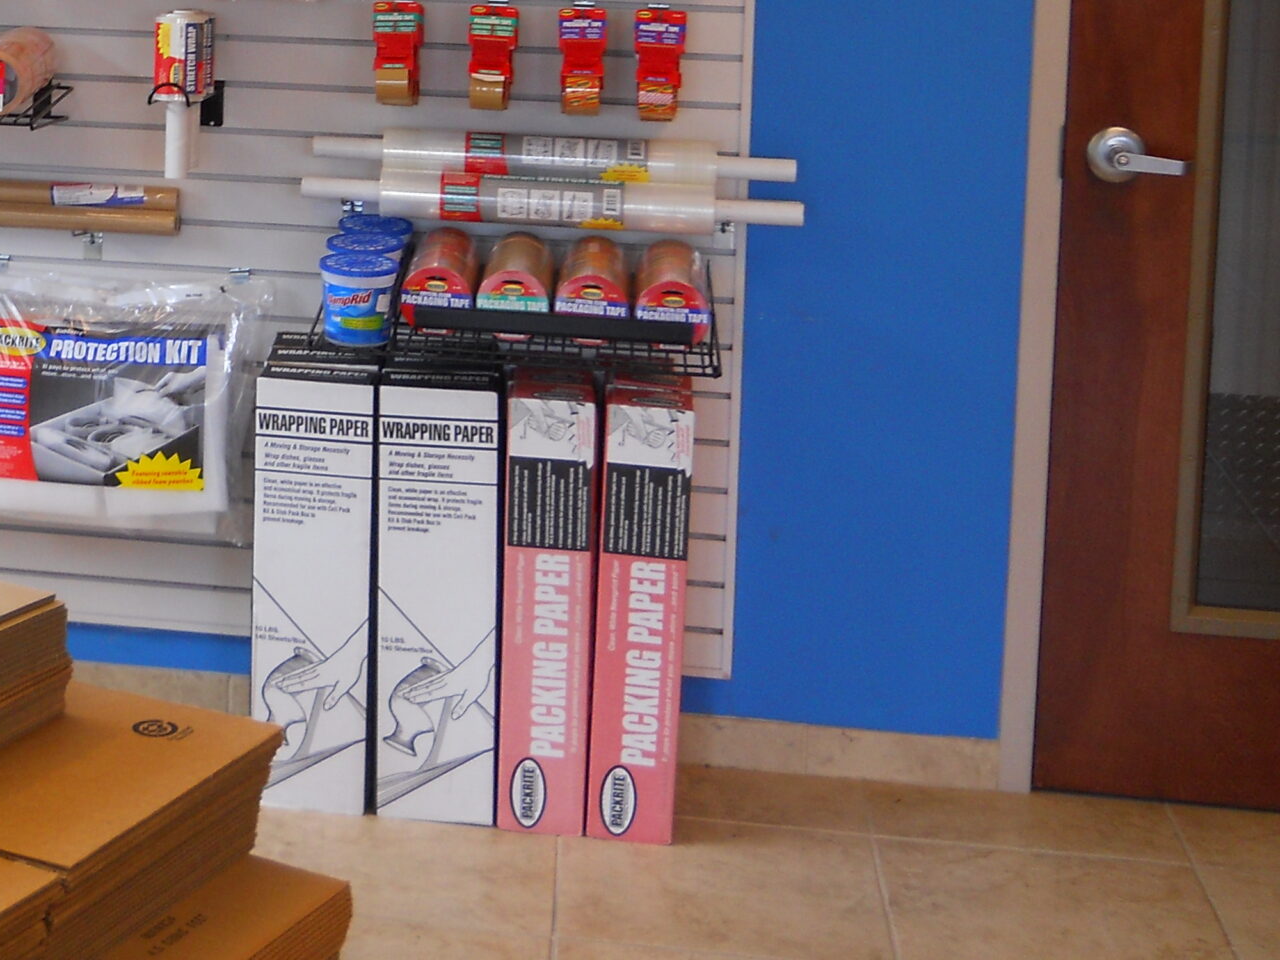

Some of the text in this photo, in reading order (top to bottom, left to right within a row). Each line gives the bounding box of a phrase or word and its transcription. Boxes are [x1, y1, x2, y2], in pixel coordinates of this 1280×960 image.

[187, 25, 197, 53] WRAP
[401, 294, 449, 308] PACKAGING
[450, 297, 470, 308] TAPE
[555, 302, 605, 315] PACKAGING
[606, 306, 626, 317] TAPE
[637, 310, 686, 322] PACKAGING
[688, 313, 708, 324] TAPE
[50, 339, 202, 365] PROTECTION KIT
[258, 411, 369, 438] WRAPPING PAPER
[382, 421, 494, 445] WRAPPING PAPER
[533, 553, 570, 636] PAPER
[627, 561, 666, 645] PAPER
[530, 642, 568, 758] PACKING
[621, 649, 663, 767] PACKING
[521, 765, 536, 819] PACKRITE
[611, 772, 626, 827] PACKRITE
